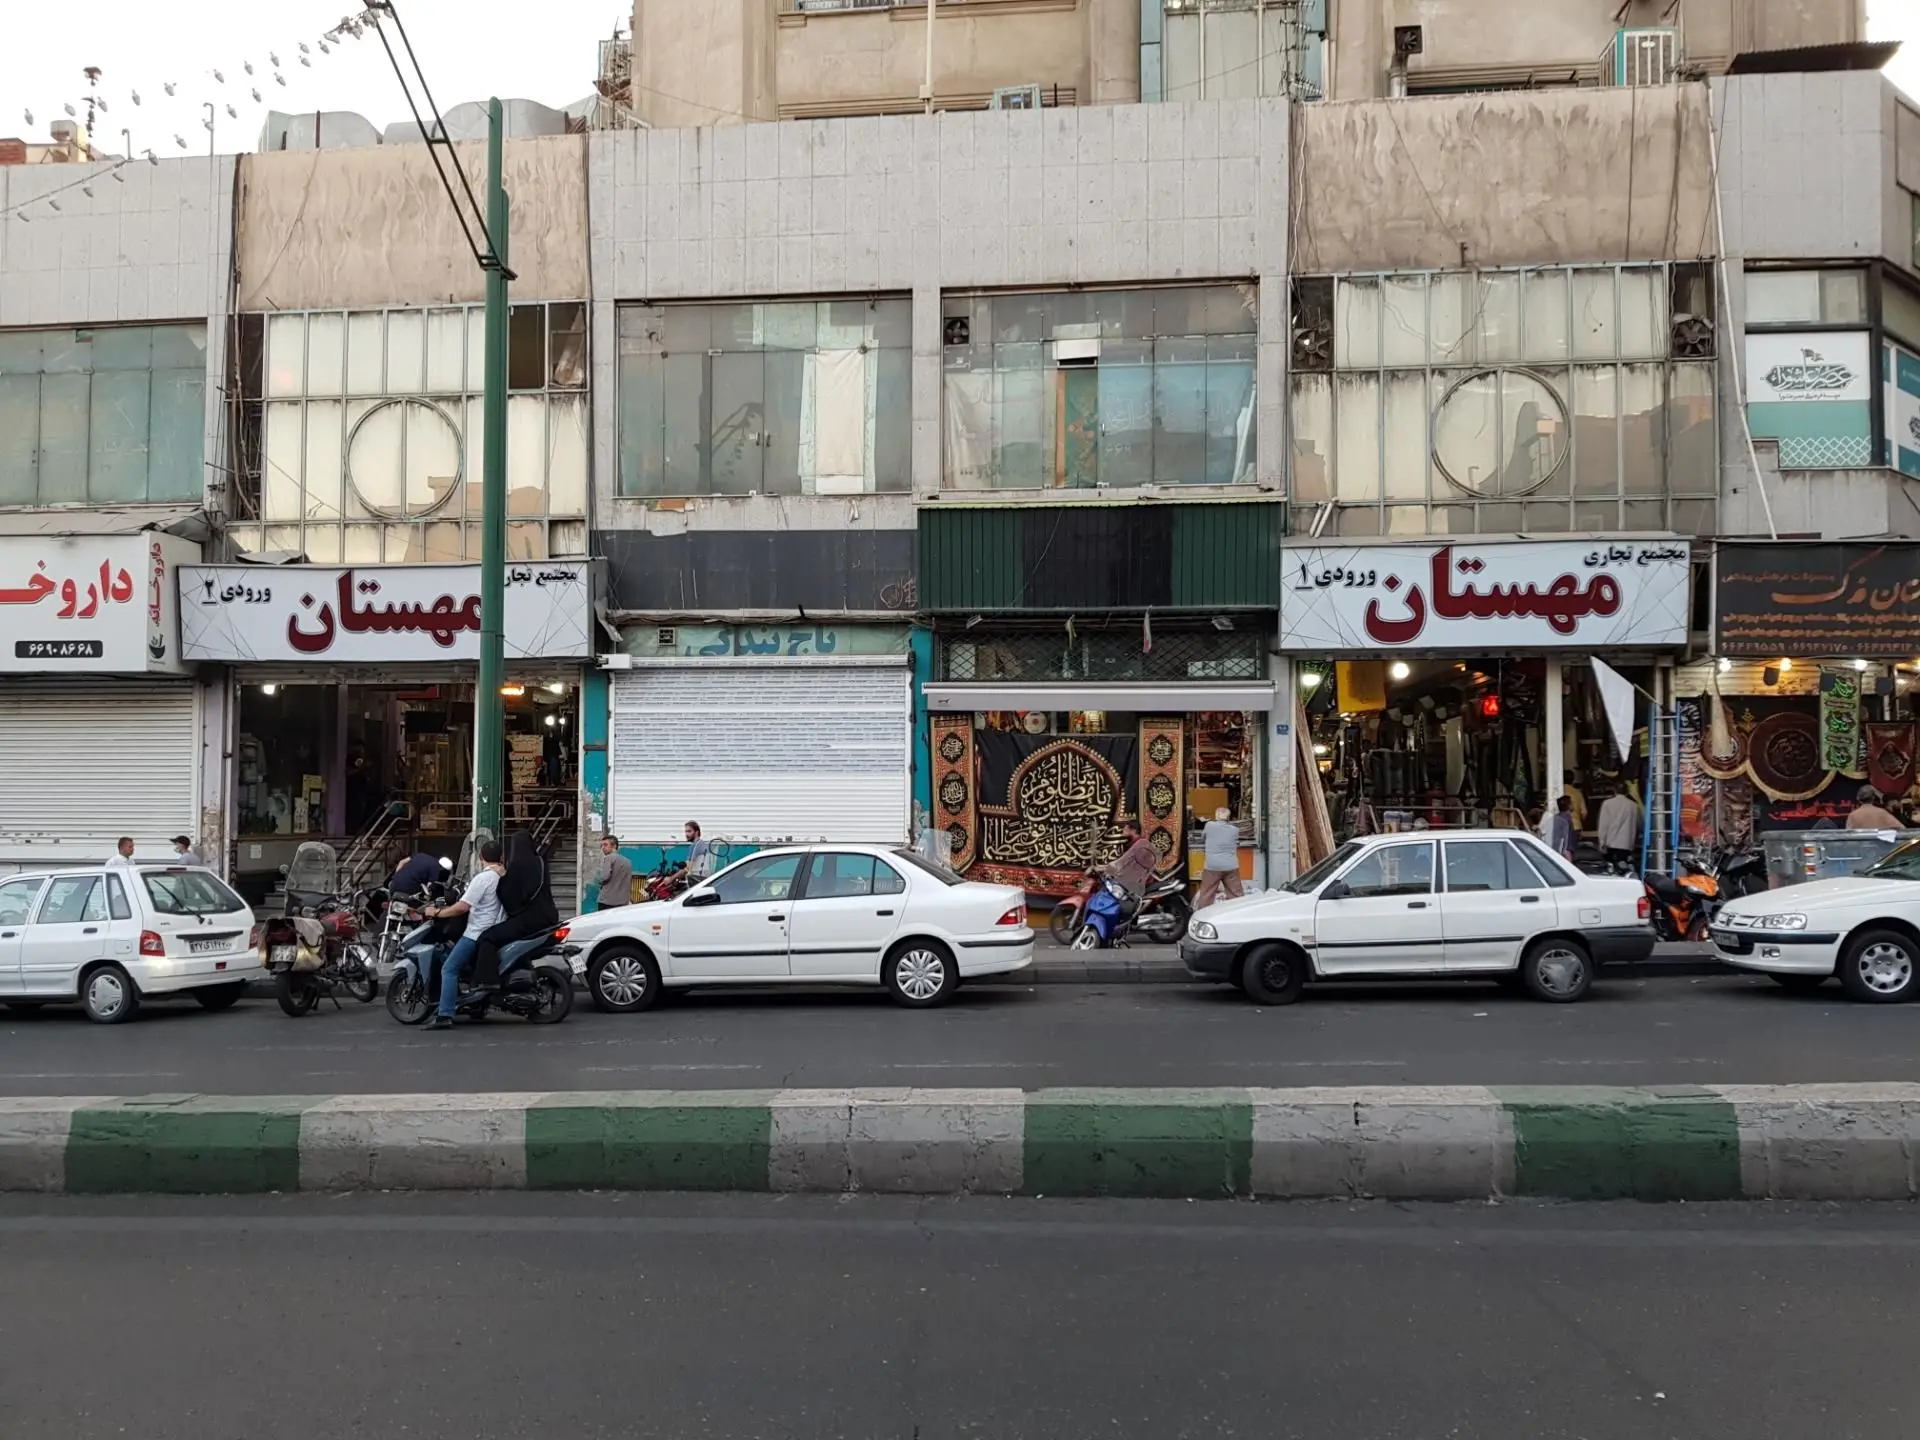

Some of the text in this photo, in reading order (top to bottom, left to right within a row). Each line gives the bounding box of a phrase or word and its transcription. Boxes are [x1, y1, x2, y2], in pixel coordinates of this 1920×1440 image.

[1584, 546, 1686, 567] مجتمع تجاری
[504, 567, 578, 587] مجتمع تجار
[1314, 566, 1377, 587] ورودی
[0, 558, 134, 619] داروخ
[220, 582, 272, 603] ورودی
[1363, 545, 1624, 645] مهستان
